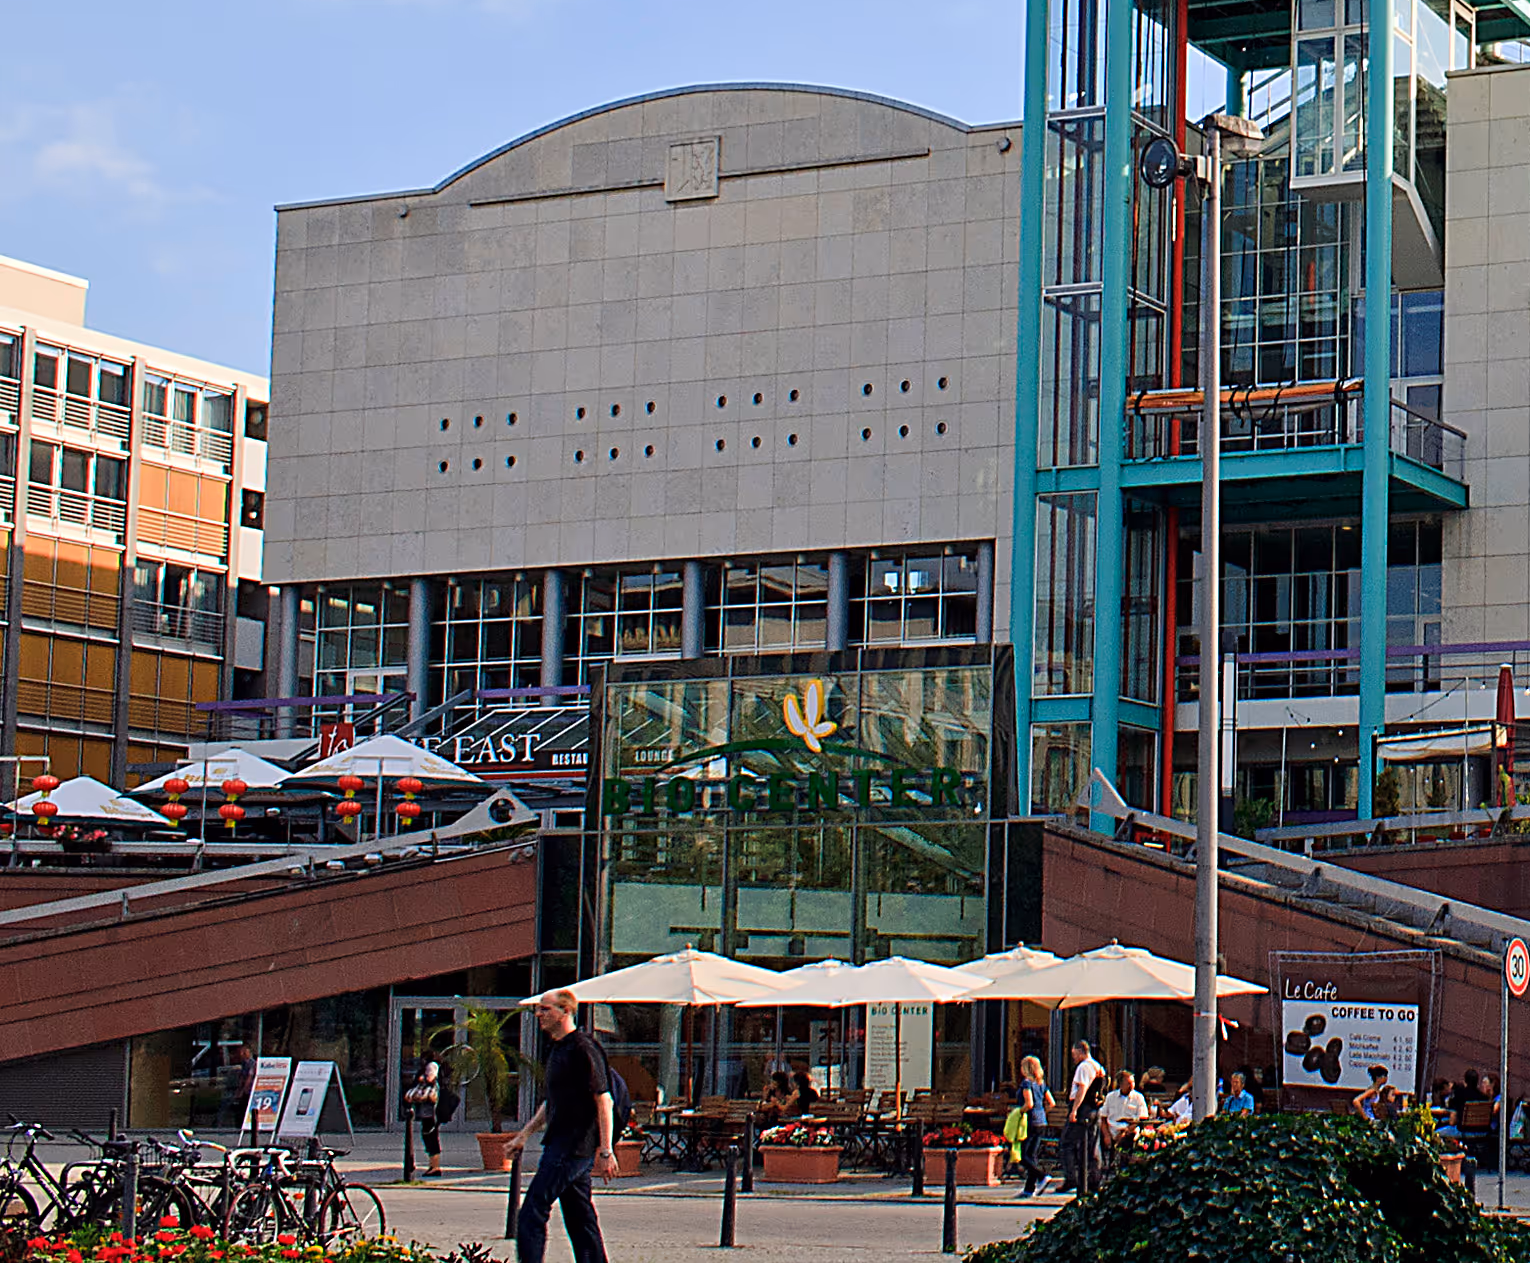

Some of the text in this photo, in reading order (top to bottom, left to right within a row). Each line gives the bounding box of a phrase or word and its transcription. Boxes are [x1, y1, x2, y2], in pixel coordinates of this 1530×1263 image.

[454, 733, 540, 765] EAST
[551, 749, 674, 767] RESTAU LOUNGE
[603, 768, 962, 815] BIO CENTER
[1512, 954, 1524, 978] 30
[1285, 977, 1301, 999] Le
[871, 1005, 929, 1017] BIO CNTER
[1331, 1006, 1415, 1022] COFFEE TO GO
